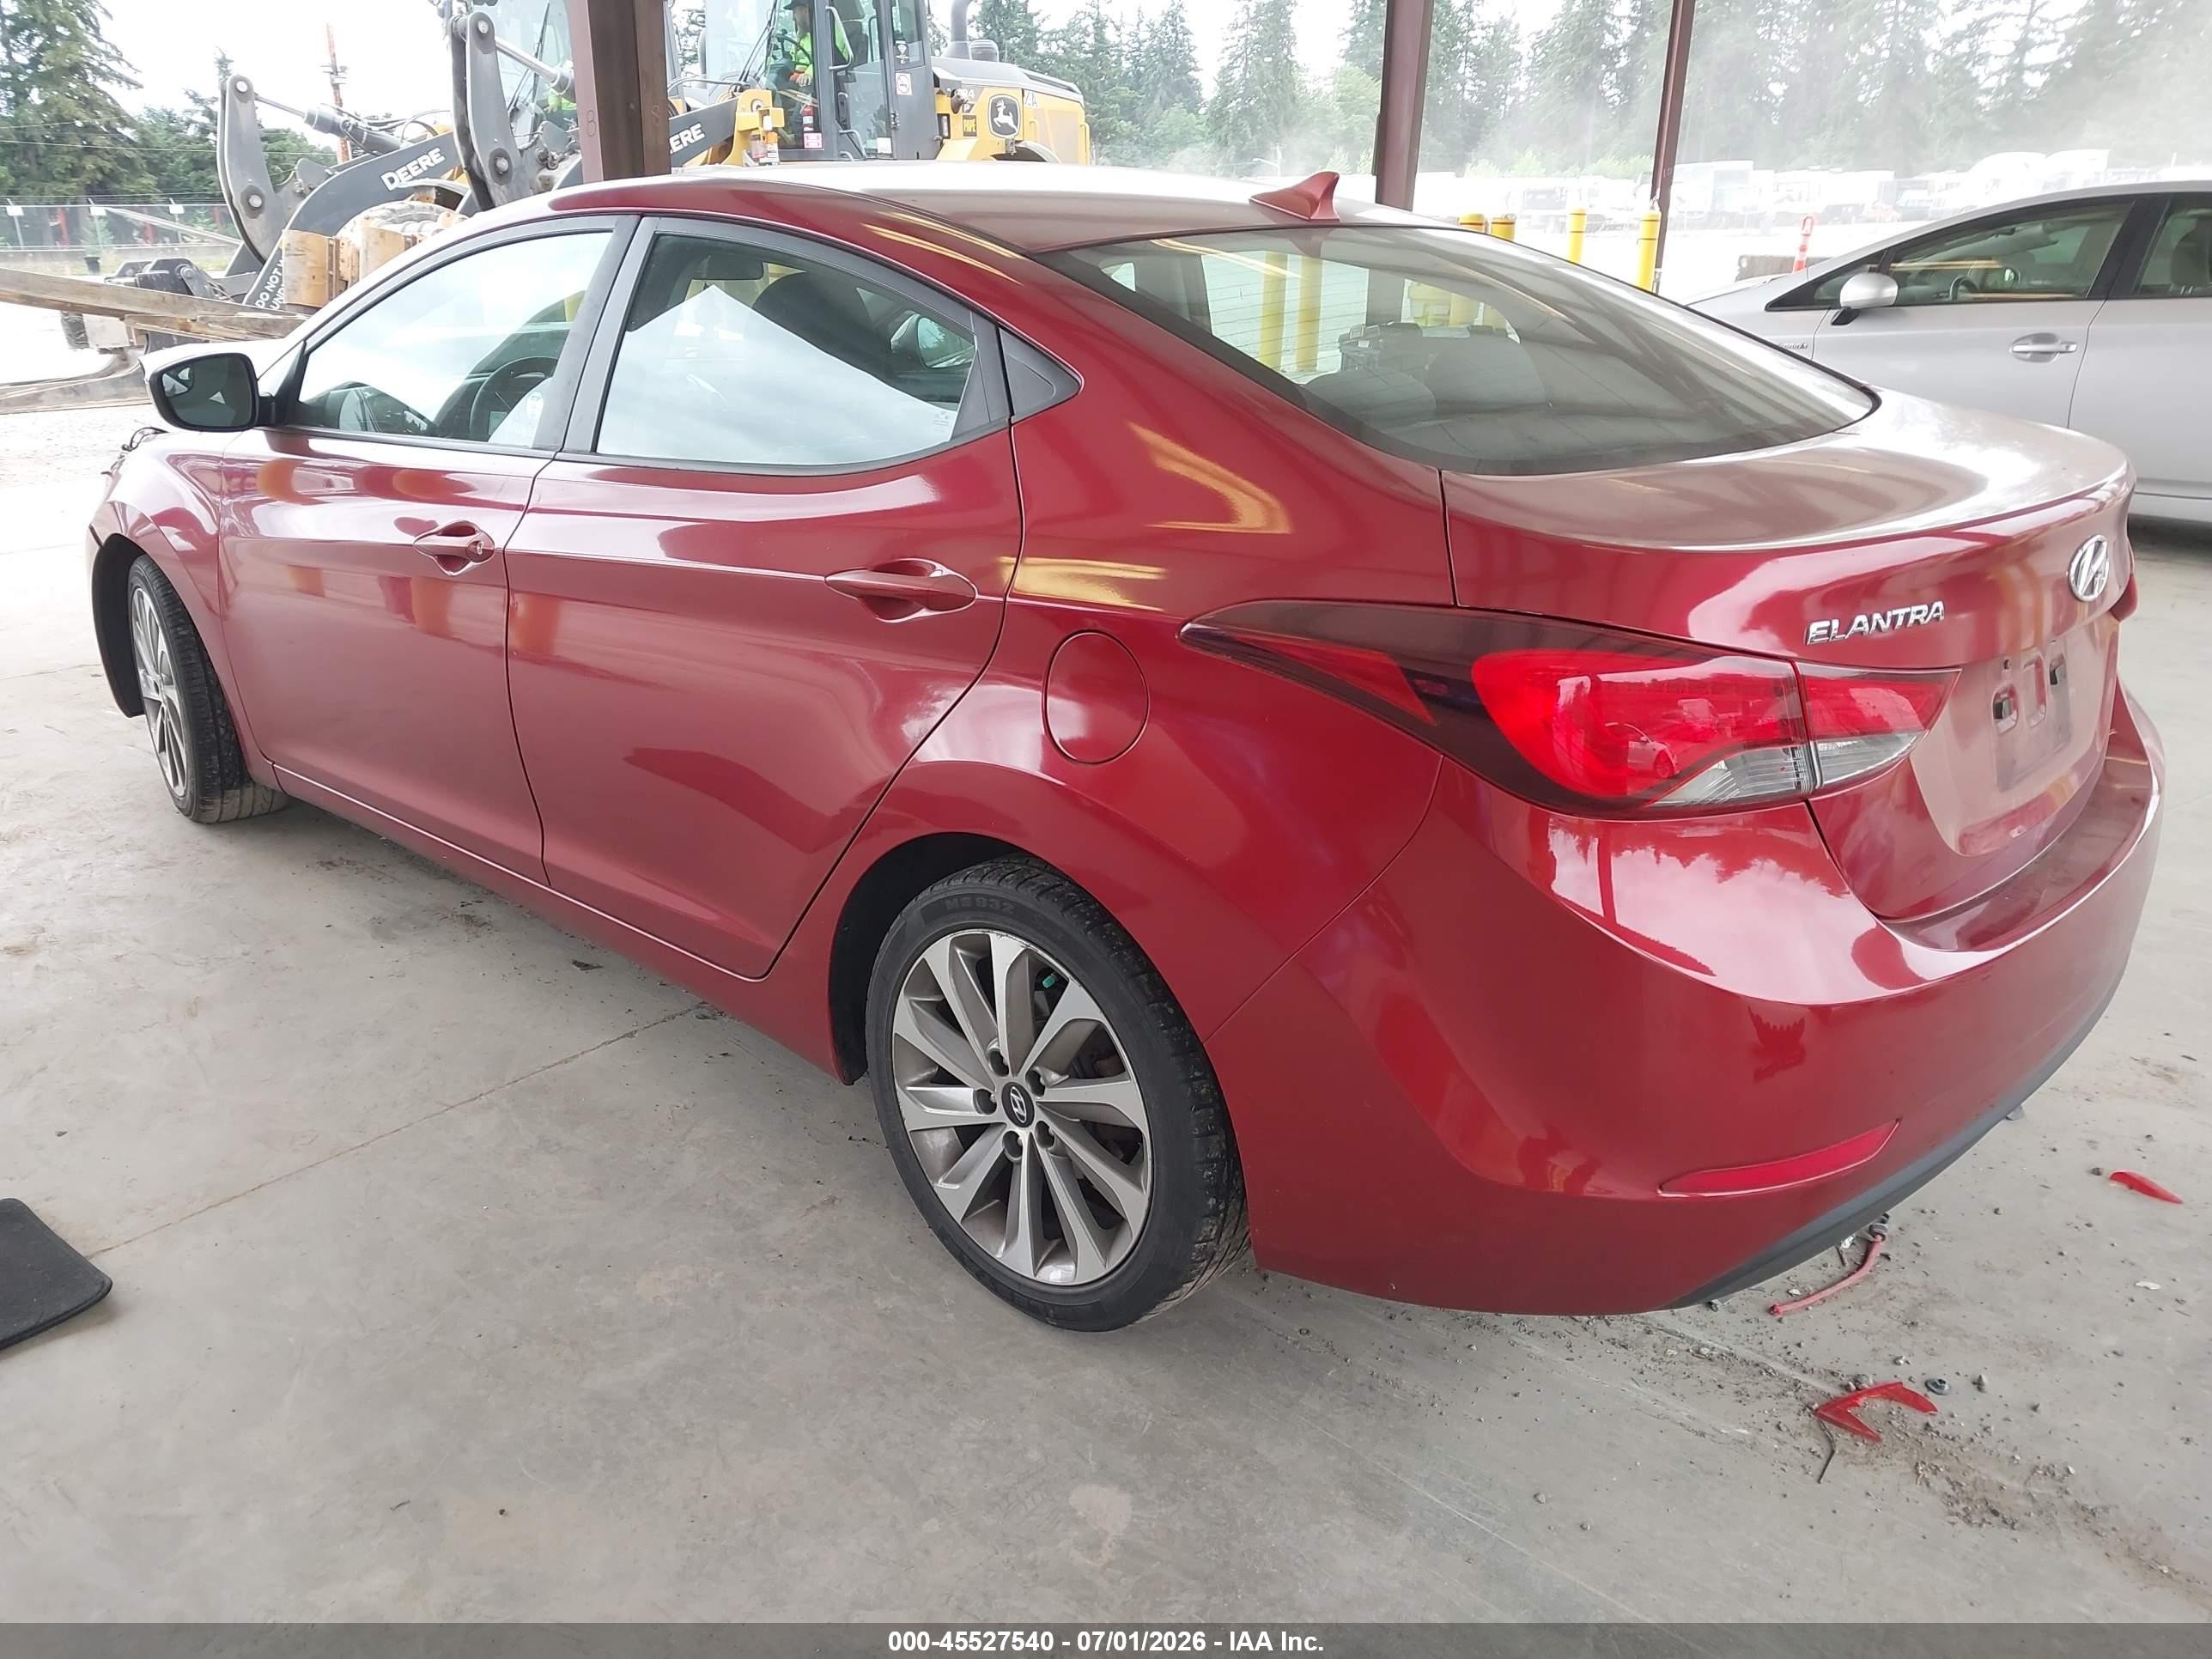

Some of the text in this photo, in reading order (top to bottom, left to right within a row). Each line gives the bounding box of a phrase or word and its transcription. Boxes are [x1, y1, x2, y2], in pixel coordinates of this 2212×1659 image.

[669, 123, 706, 155] ERE
[380, 147, 447, 191] DEERE
[255, 267, 283, 308] DO NOT
[1806, 600, 1945, 646] ELANTRA
